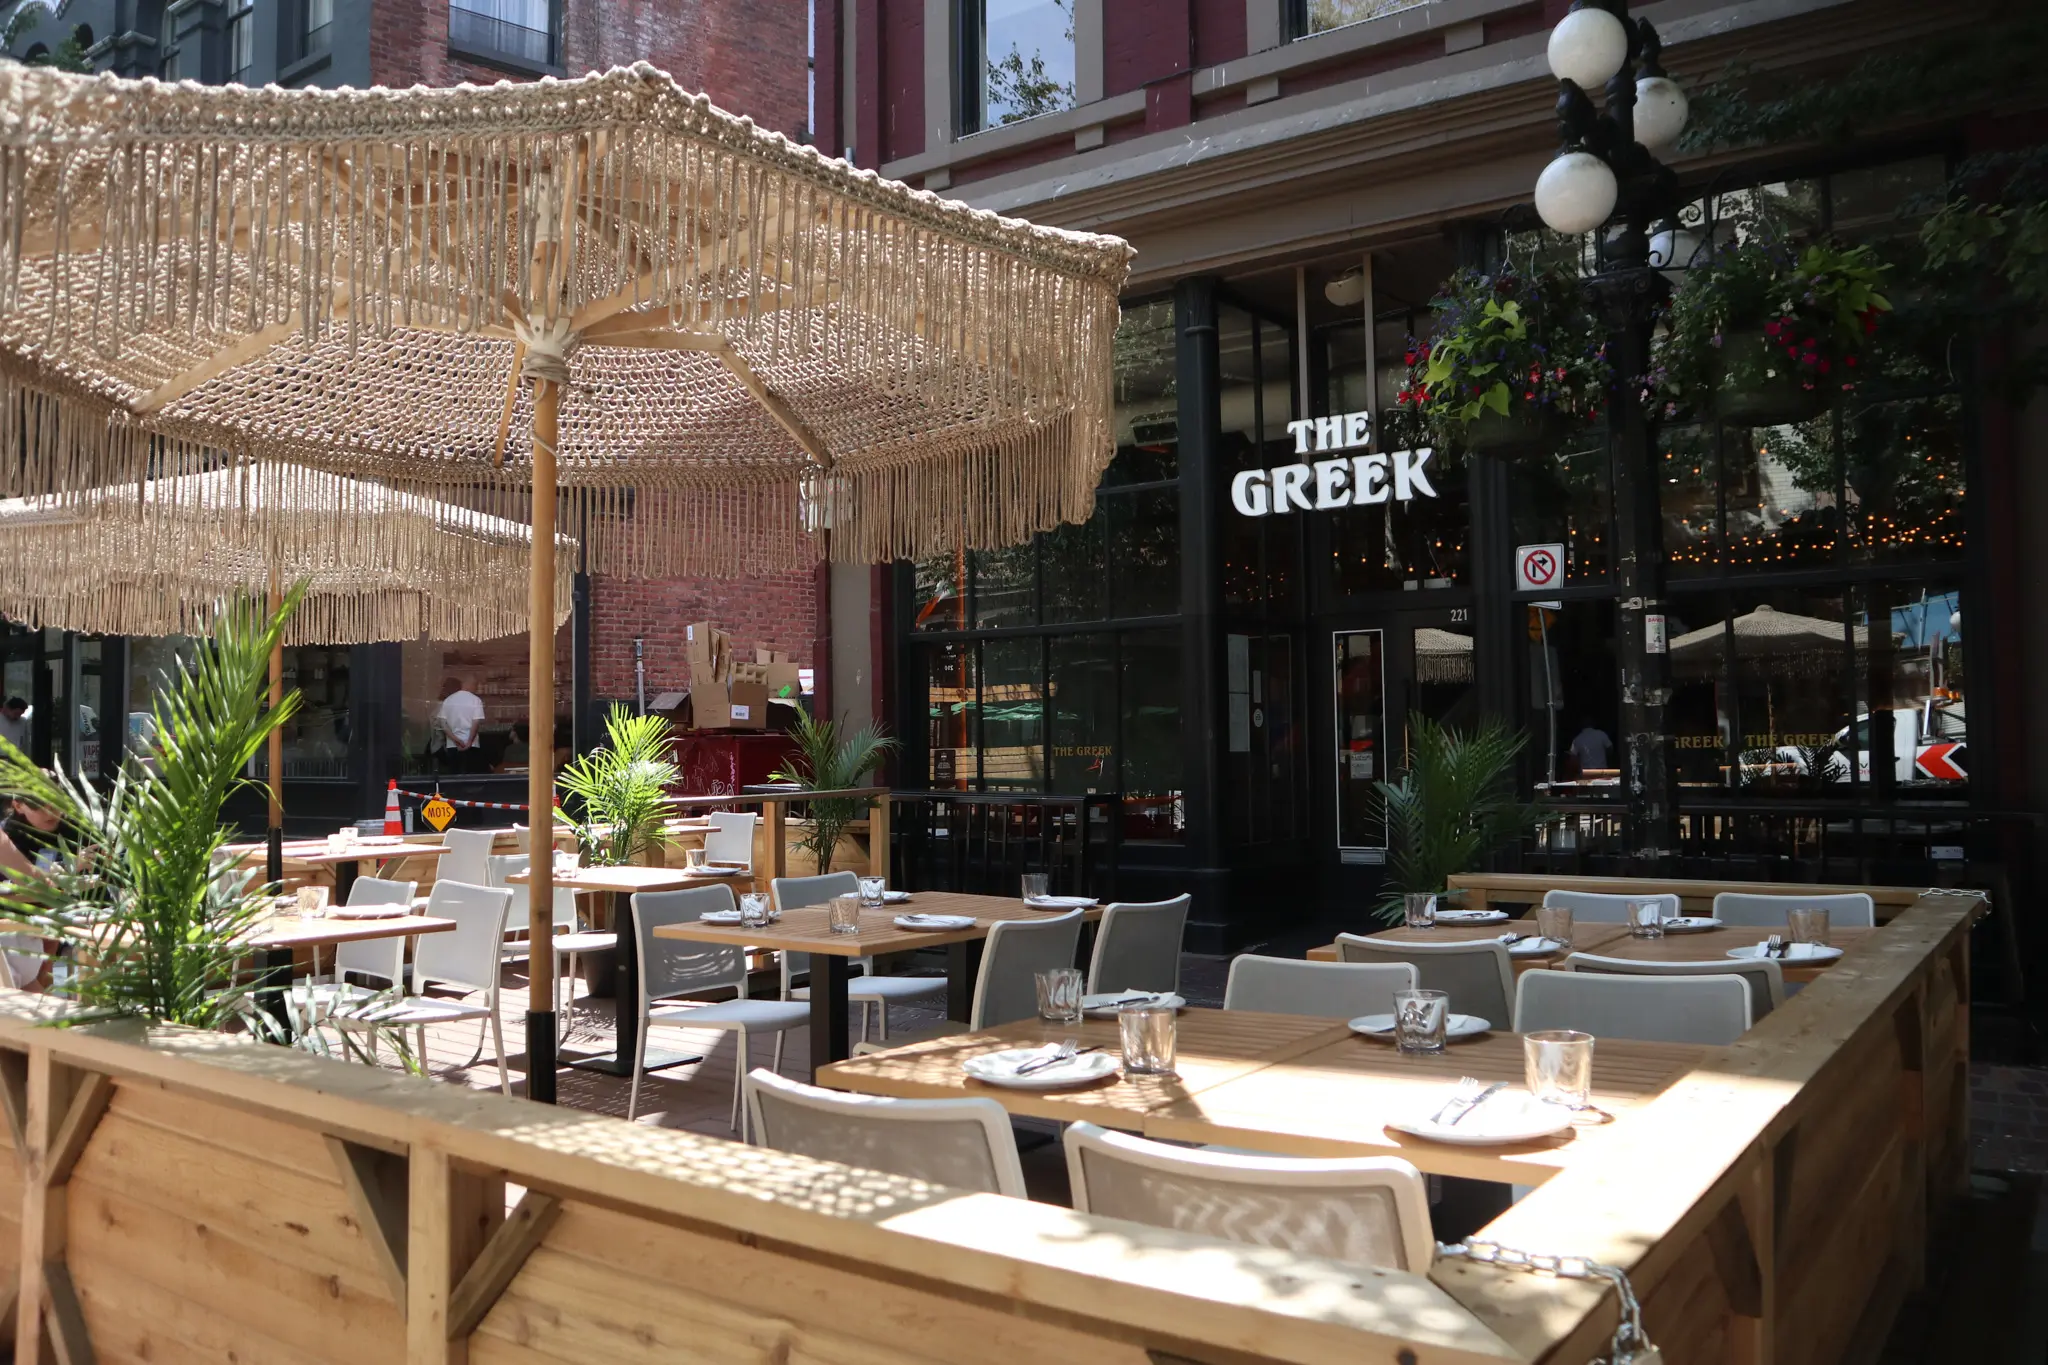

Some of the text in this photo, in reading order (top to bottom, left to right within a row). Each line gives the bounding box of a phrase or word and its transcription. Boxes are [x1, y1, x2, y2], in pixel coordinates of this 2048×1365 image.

[1287, 411, 1371, 454] THE
[1231, 447, 1438, 517] GREEK
[1450, 608, 1468, 622] 221
[1744, 734, 1777, 747] THE
[1052, 745, 1113, 757] THE GREEK
